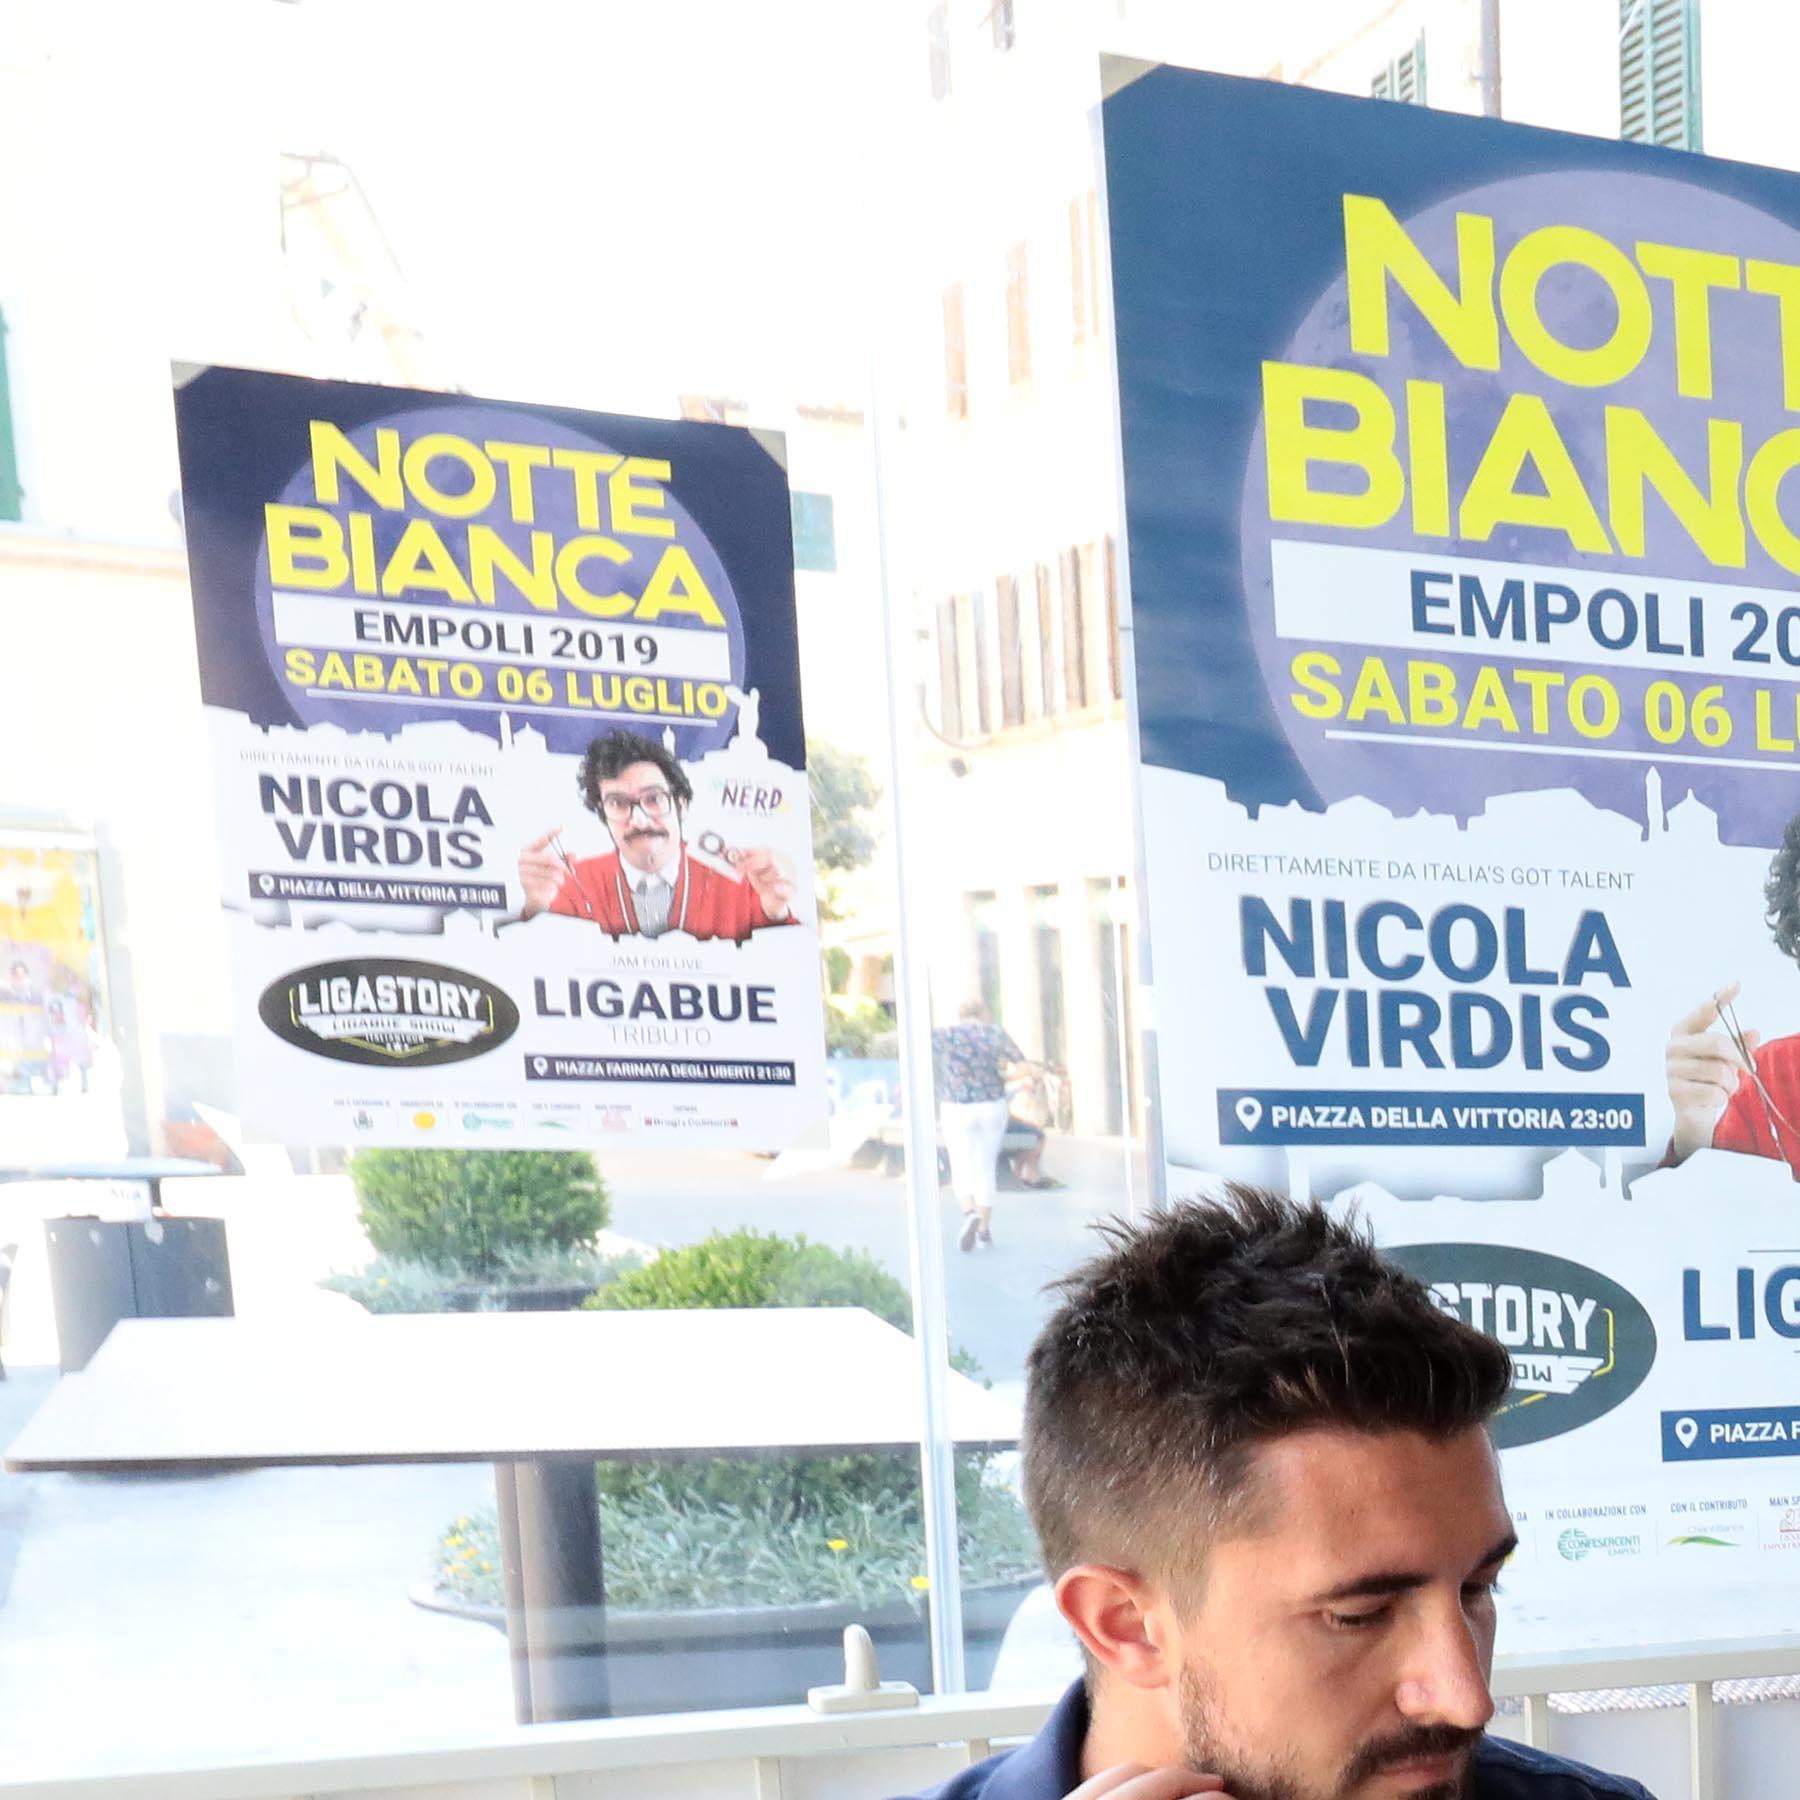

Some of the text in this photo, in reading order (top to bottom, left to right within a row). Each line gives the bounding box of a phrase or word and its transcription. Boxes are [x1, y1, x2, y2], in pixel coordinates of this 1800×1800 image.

[308, 420, 675, 539] NOTTE
[264, 503, 726, 627] BIANCA
[1410, 569, 1707, 659] EMPOLI
[354, 610, 659, 666] EMPOLI 2019
[284, 645, 728, 717] SABATO 06 LUGLIO
[1290, 652, 1622, 739] SABATO
[1643, 688, 1733, 748] 06
[258, 773, 494, 826] NICOLA
[721, 785, 782, 810] NERD
[274, 821, 484, 869] VIRDIS
[279, 879, 457, 902] PIAZZA DELLA VITTORIA
[1207, 851, 1635, 891] DIRETTAMENTE DA ITALIA'S GOT TALENT
[1239, 893, 1632, 988] NICOLA
[298, 975, 480, 1019] LIGASTORY
[533, 977, 778, 1024] LIGABUE
[607, 1023, 712, 1047] TRIBUTO
[1264, 985, 1611, 1072] VIRDIS
[554, 1059, 709, 1079] PIAZZA FARINATA DEGLI
[1272, 1105, 1633, 1131] PIAZZA DELLA VITTORIA 23:00
[1710, 1420, 1787, 1444] PIAZZA
[1557, 1506, 1627, 1519] COLLABORAZIONE
[1700, 1499, 1748, 1511] CONTRIBUTO
[1769, 1496, 1789, 1506] MAIN
